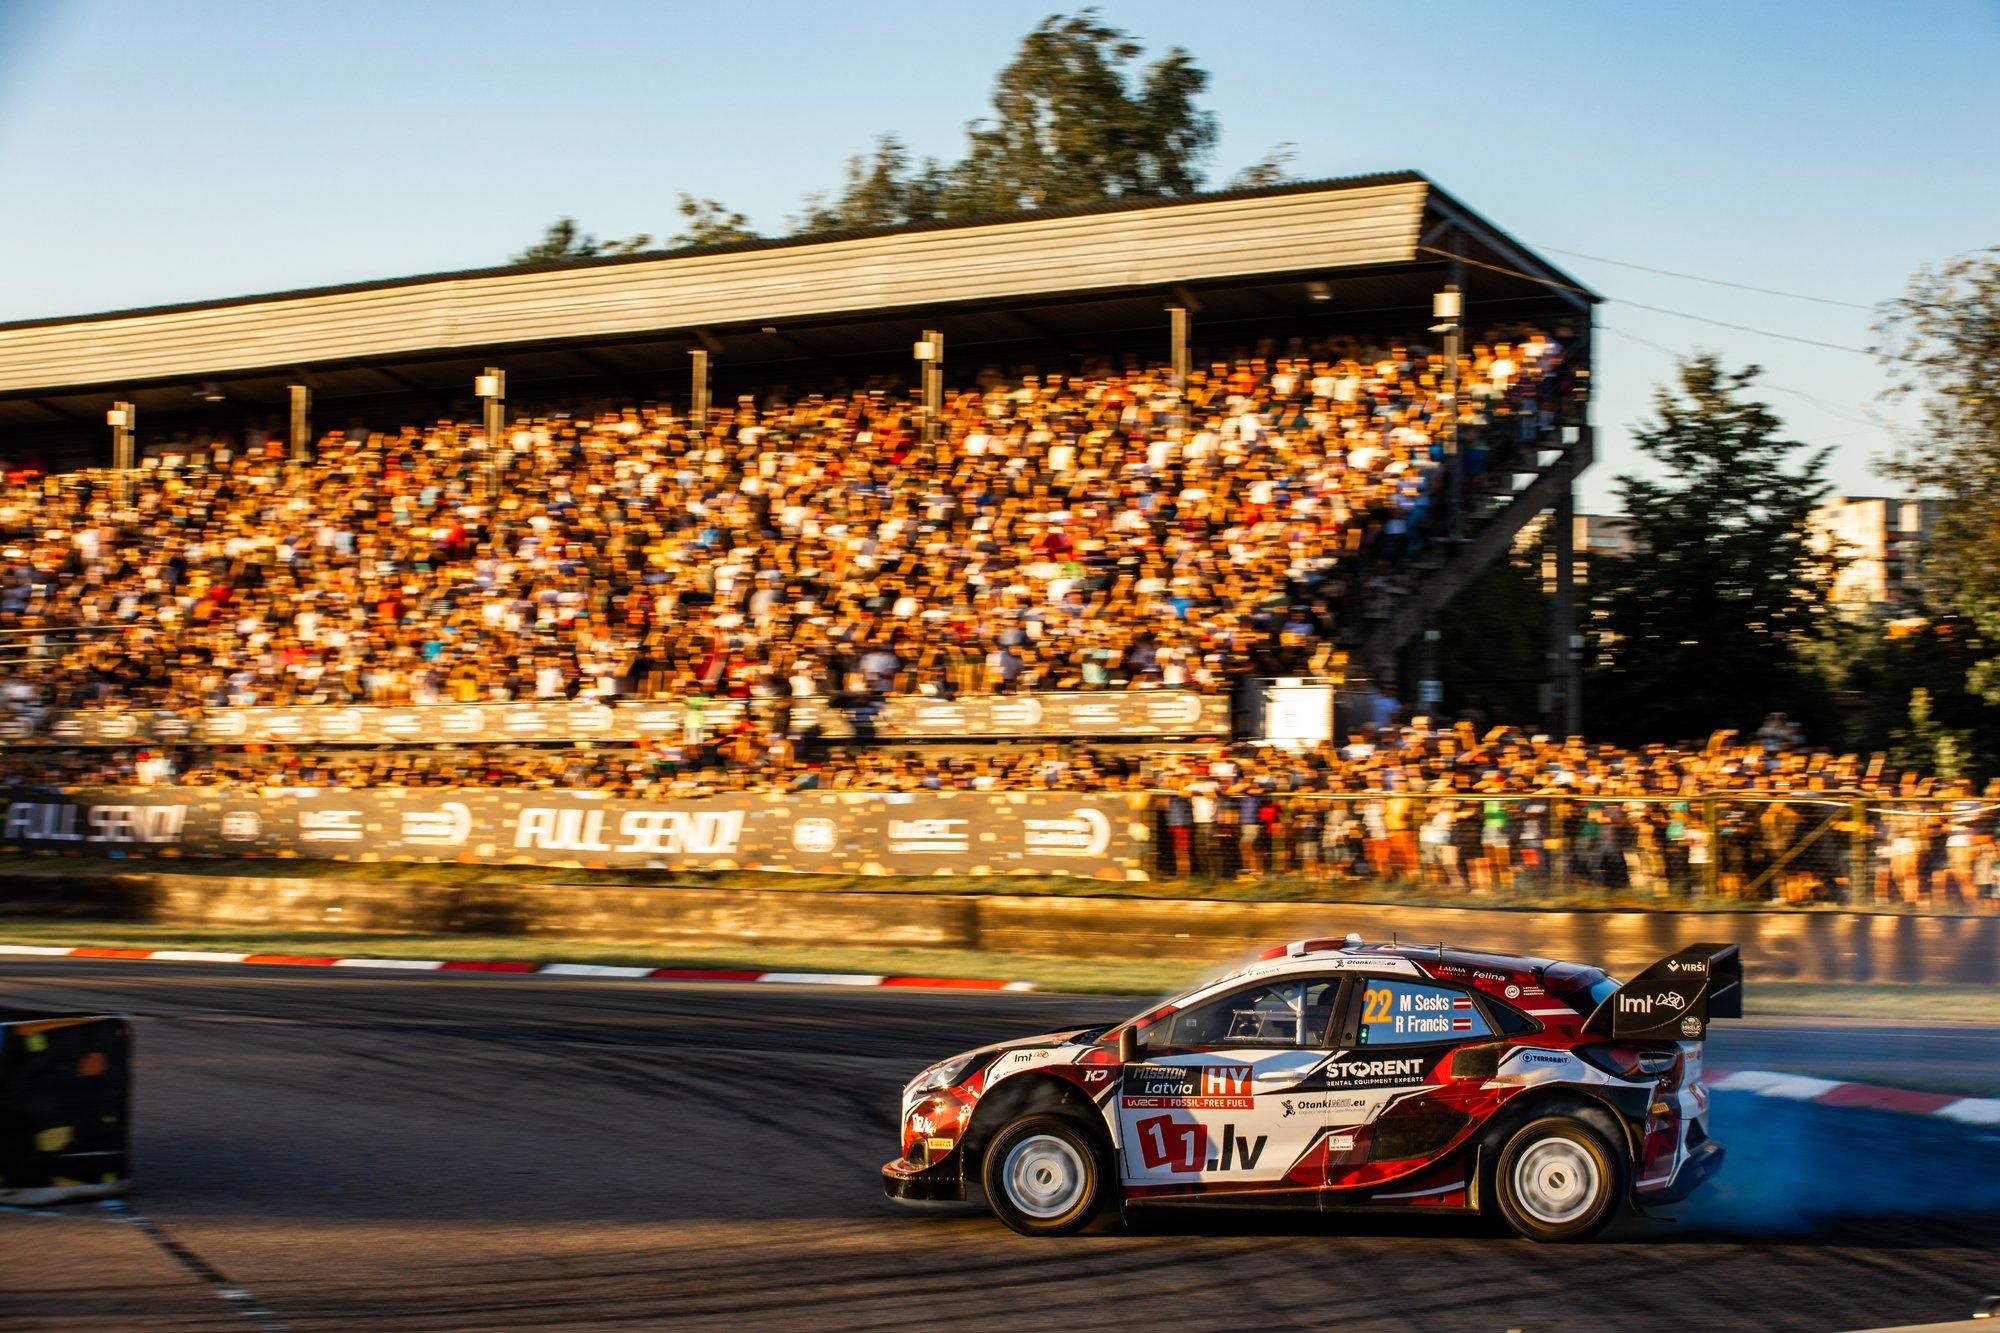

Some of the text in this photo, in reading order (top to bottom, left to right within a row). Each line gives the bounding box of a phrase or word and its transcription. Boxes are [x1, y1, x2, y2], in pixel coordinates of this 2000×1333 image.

[86, 805, 188, 842] SEND!
[514, 808, 611, 851] FULL
[614, 810, 745, 853] SEND!
[1439, 965, 1466, 973] LAUMA
[1681, 961, 1706, 971] VIRŠI
[1472, 970, 1506, 981] Felina
[1362, 989, 1393, 1024] 22
[1400, 993, 1449, 1011] M Sesks
[1620, 994, 1654, 1013] lmt
[1395, 1014, 1449, 1033] R Francis
[1532, 1055, 1569, 1063] TERRABALT
[1133, 1067, 1187, 1080] MISSION
[1326, 1059, 1424, 1078] STORENT
[1144, 1081, 1194, 1094] Latvia
[1207, 1068, 1249, 1094] HY
[1354, 1078, 1393, 1086] EQUIPMENT
[1170, 1098, 1248, 1107] FOSSIL-FREE FUEL
[1148, 1122, 1268, 1171] 11.lv
